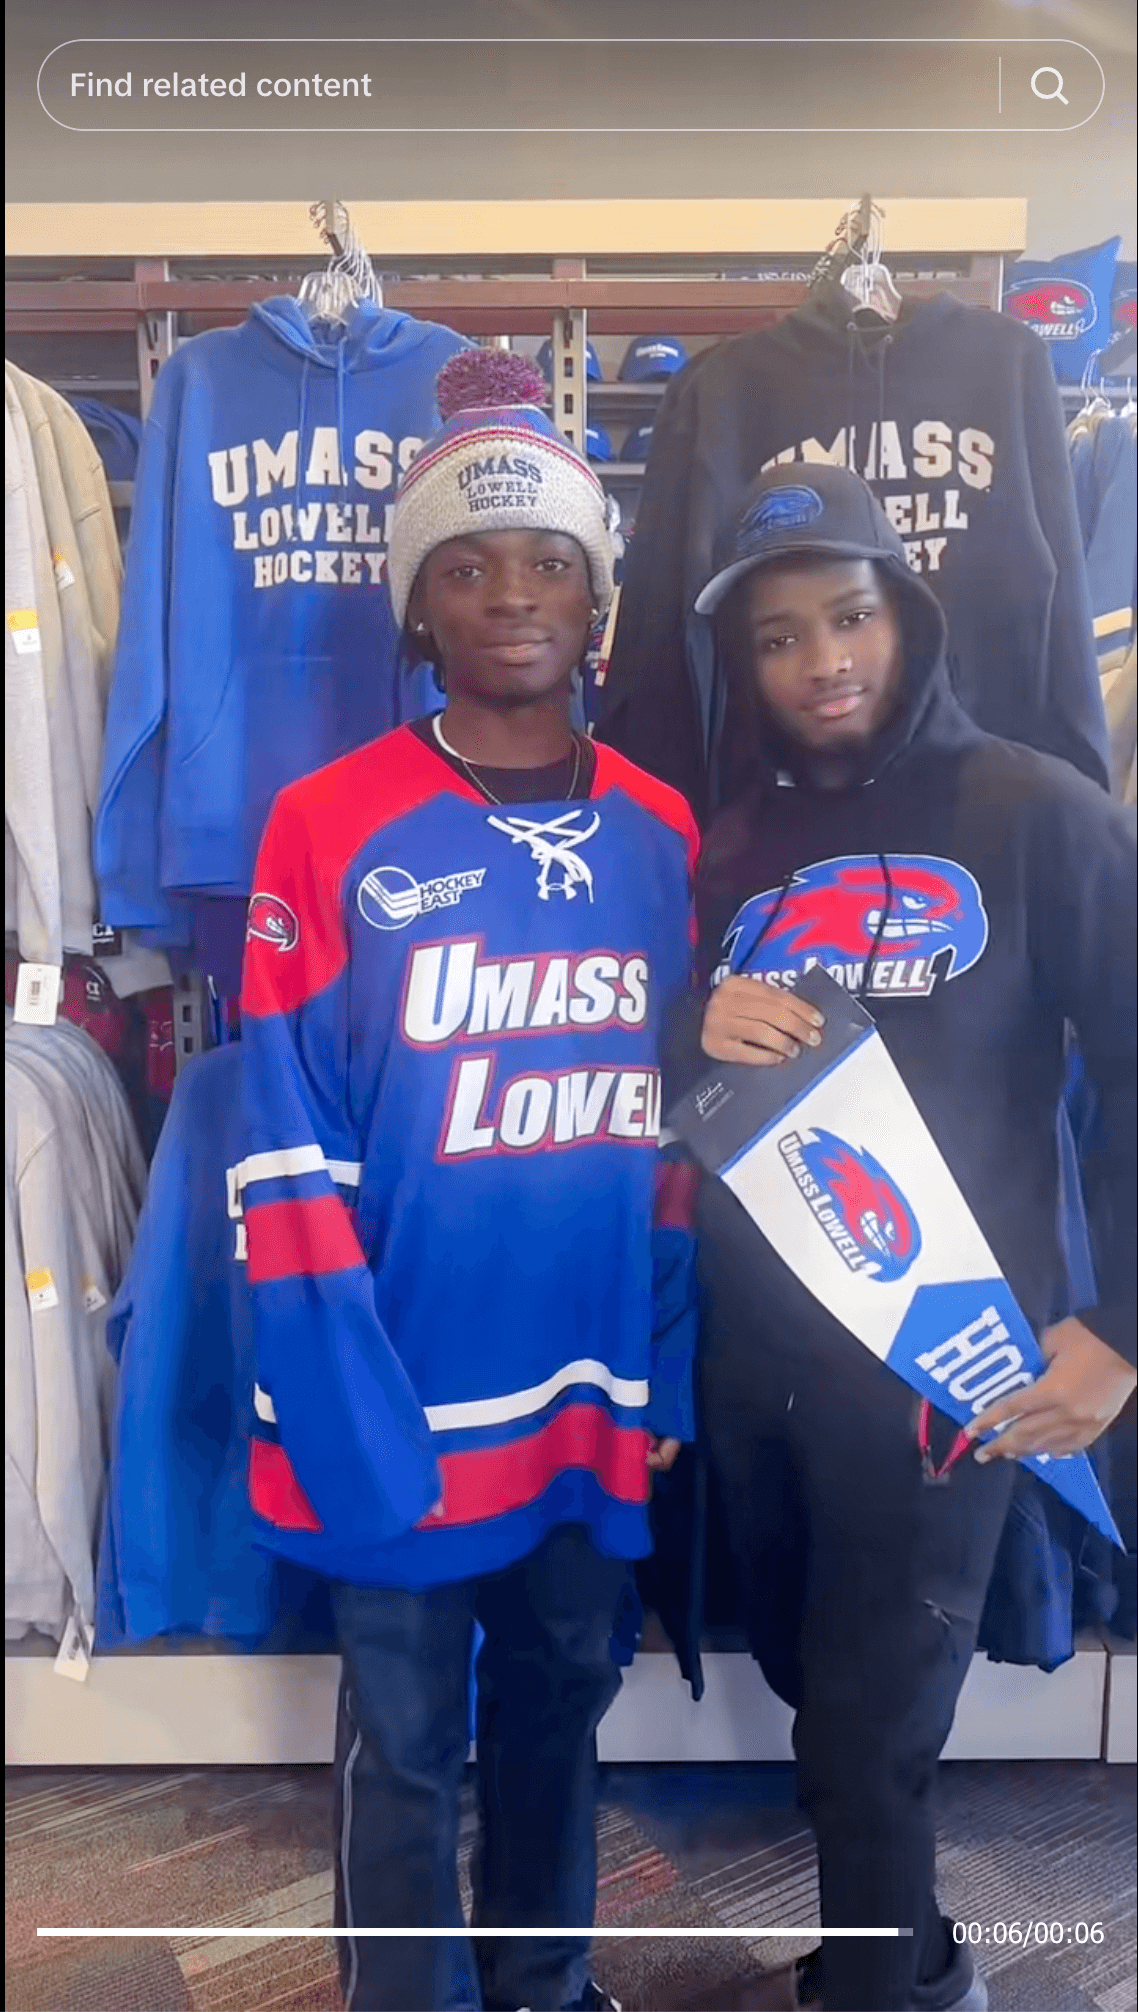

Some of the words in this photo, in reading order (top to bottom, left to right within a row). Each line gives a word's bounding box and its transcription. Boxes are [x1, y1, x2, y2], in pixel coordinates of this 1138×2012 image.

[458, 455, 543, 490] UMASS
[467, 481, 537, 498] LOWELL
[469, 495, 537, 512] HOCKEY
[884, 490, 968, 534] ELL
[254, 550, 387, 588] HOCKEY
[419, 873, 482, 897] HOCKEY
[421, 890, 459, 910] EAST
[803, 957, 926, 989] OWELL
[810, 1193, 868, 1269] LOWELL
